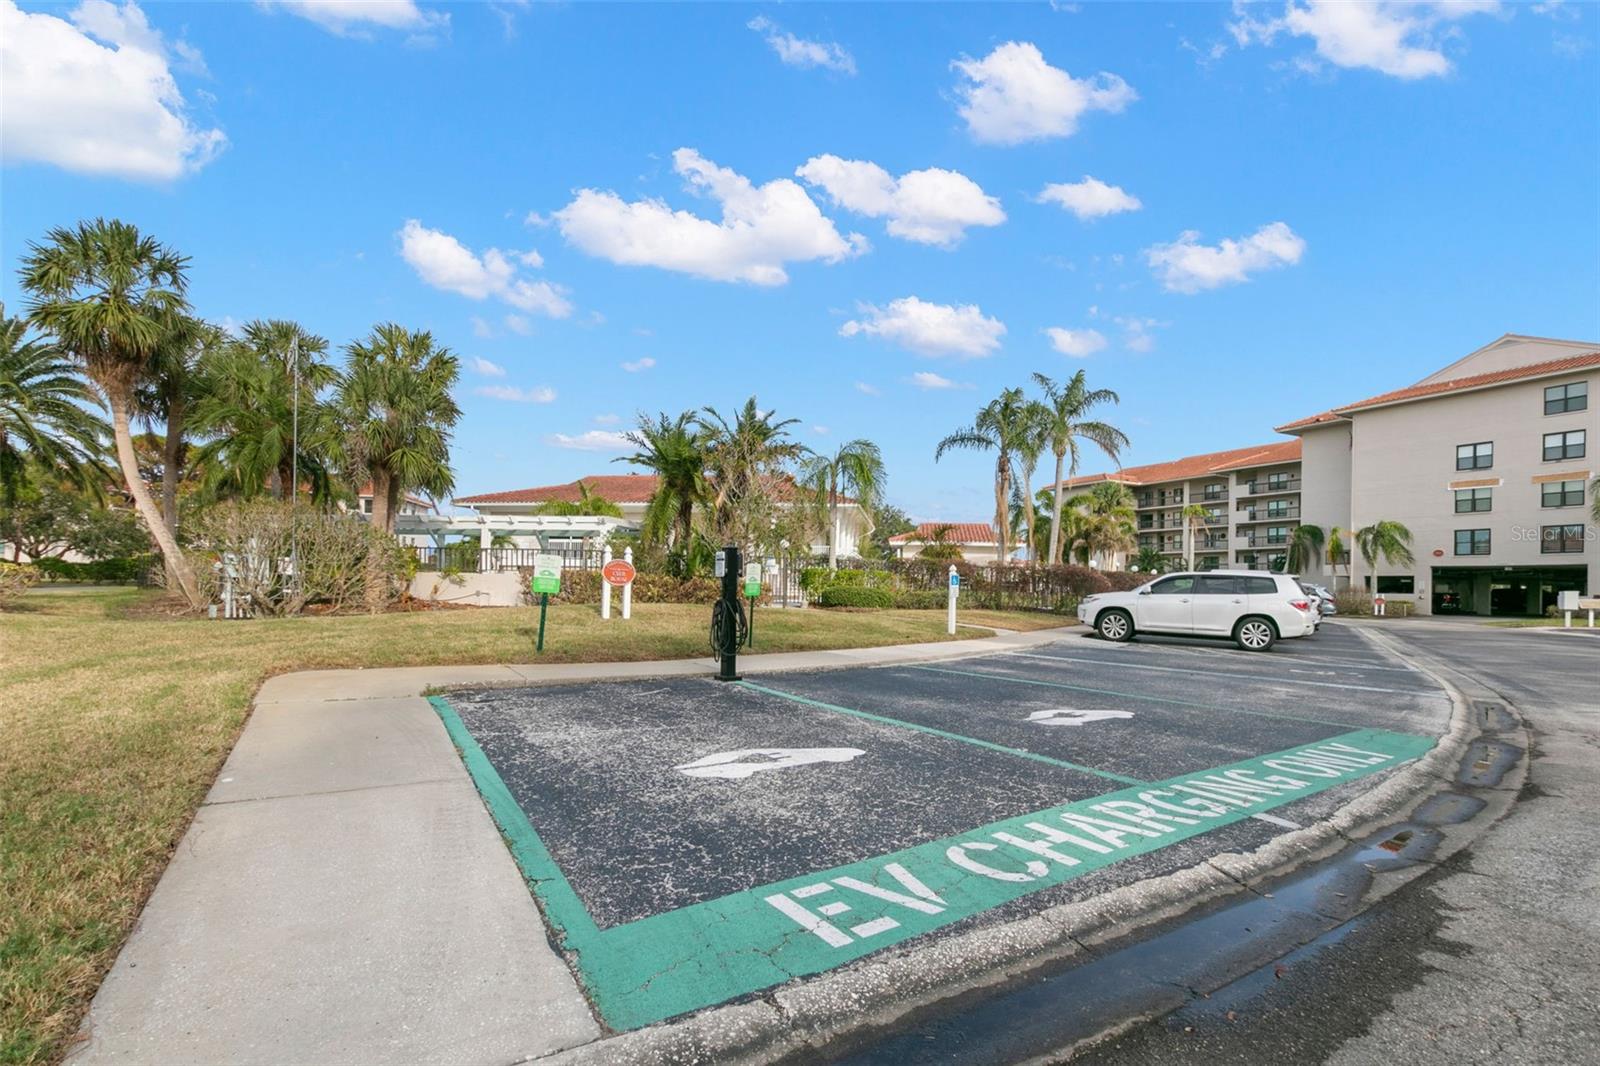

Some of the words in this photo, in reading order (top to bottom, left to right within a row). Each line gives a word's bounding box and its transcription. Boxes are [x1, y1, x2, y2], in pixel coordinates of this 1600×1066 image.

[764, 862, 948, 948] EV
[946, 769, 1312, 882] CHARGING
[1263, 743, 1394, 777] ONLY
